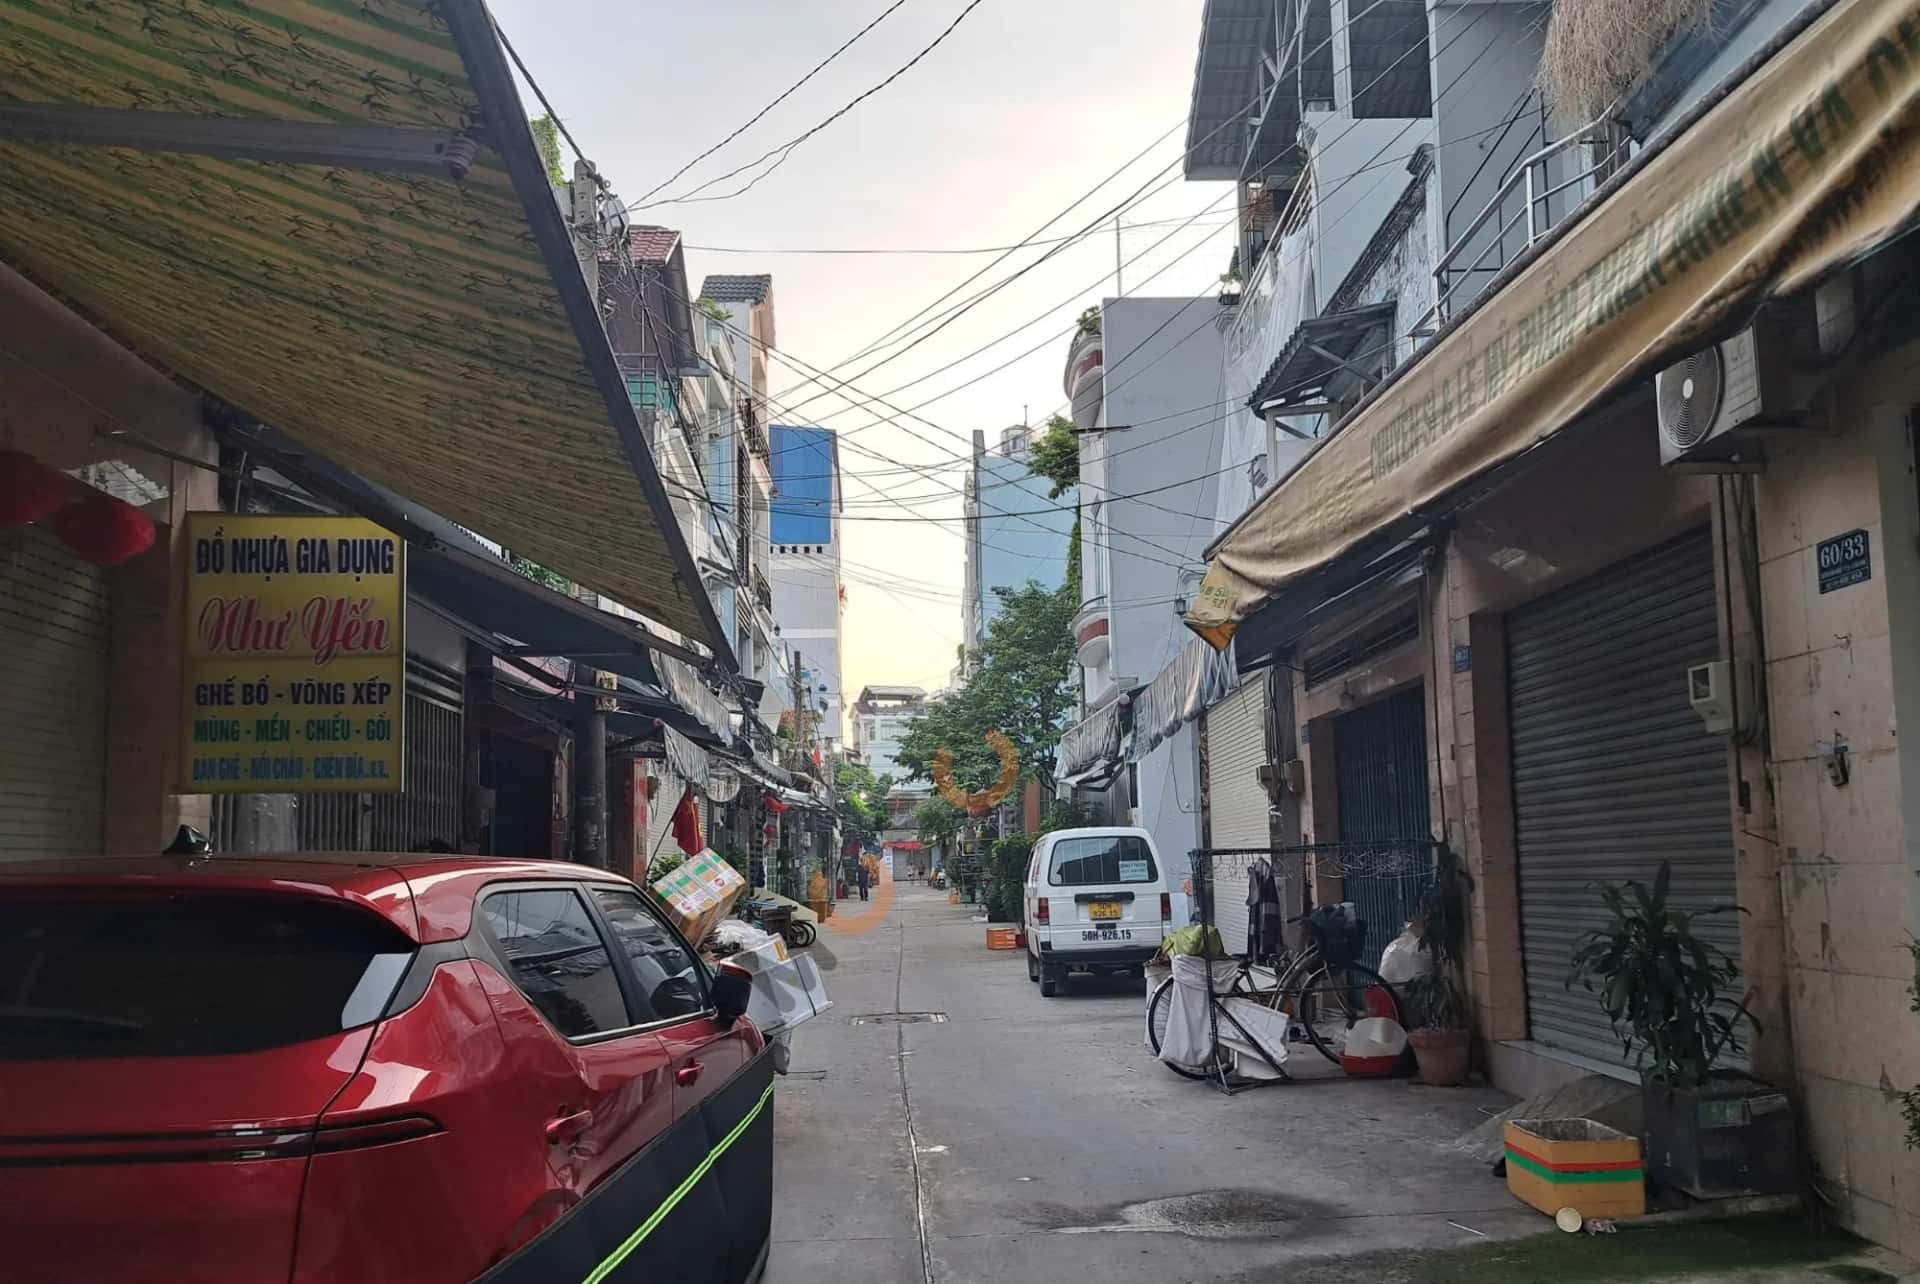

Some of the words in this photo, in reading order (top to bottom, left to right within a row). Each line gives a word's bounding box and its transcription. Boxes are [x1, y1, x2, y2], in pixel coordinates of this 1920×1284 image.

[232, 535, 289, 582] NHỰA
[296, 538, 330, 574] GIA
[338, 538, 394, 582] DỤNG
[1820, 534, 1865, 569] 60/33
[198, 597, 293, 651] Như
[302, 597, 390, 666] Yến
[195, 675, 236, 706] GHẾ
[290, 678, 345, 705] VÕNG
[352, 675, 391, 705] XẾP
[306, 711, 351, 741] CHIẾU
[1081, 929, 1132, 941] 50H-926.15
